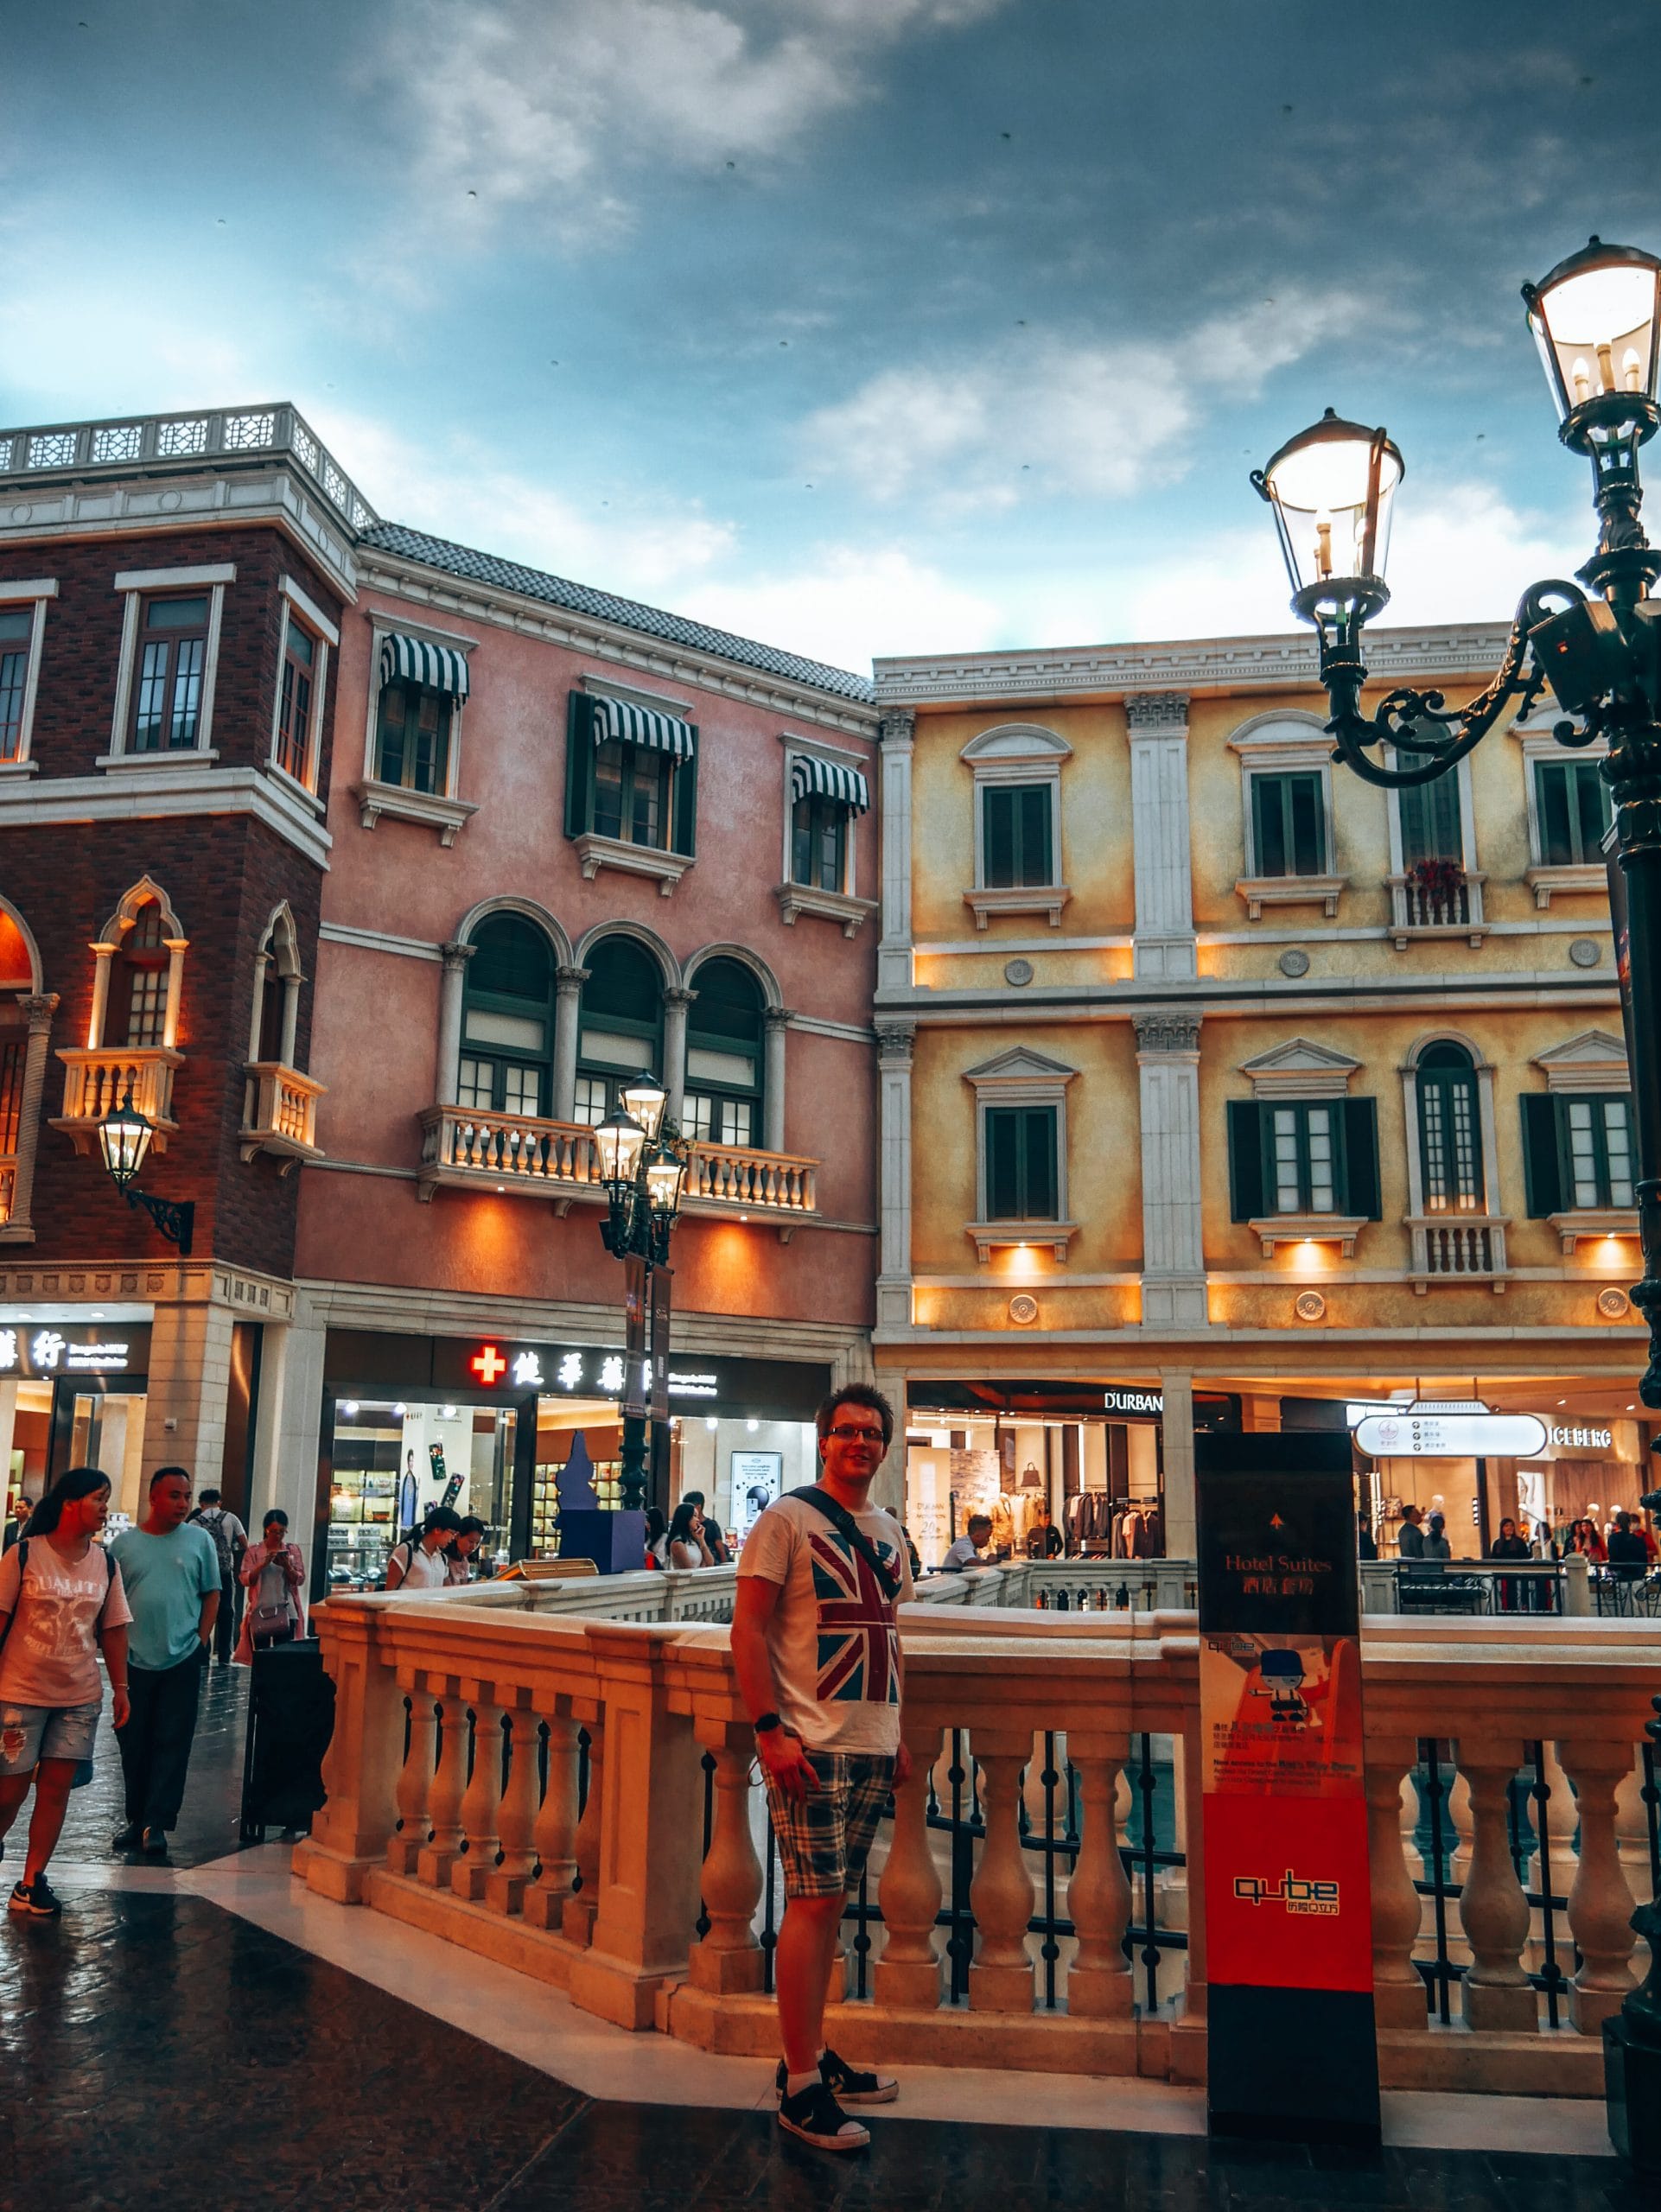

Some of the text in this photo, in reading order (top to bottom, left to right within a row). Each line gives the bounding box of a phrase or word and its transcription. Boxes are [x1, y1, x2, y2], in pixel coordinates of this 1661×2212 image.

[1104, 1392, 1163, 1412] D'URBAN
[1548, 1427, 1612, 1447] ICEBERG
[1225, 1554, 1332, 1572] Hotel Suites
[1234, 1869, 1339, 1906] qube
